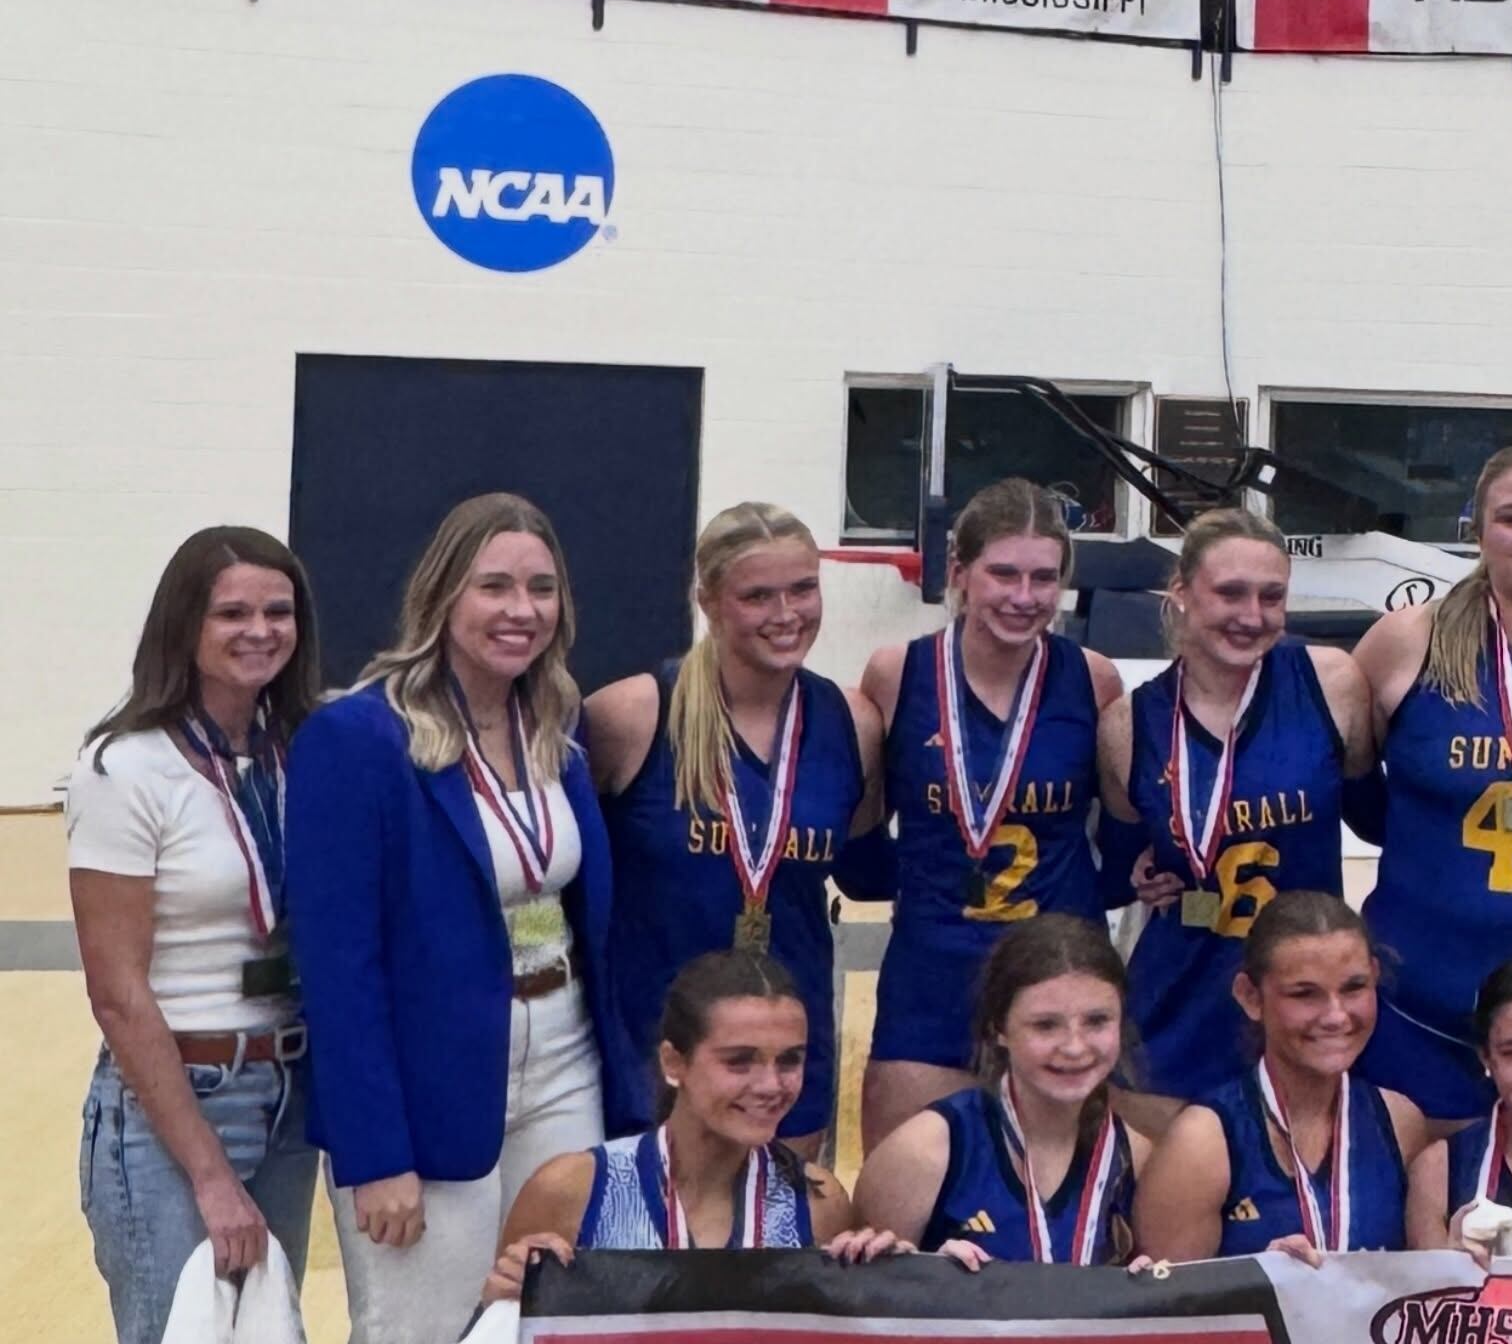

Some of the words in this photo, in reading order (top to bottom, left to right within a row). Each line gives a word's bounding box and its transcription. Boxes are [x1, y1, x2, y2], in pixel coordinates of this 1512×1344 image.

[432, 166, 608, 226] NCAA
[925, 780, 1073, 817] SALL
[686, 819, 834, 863] SUALL
[962, 823, 1039, 922] 2
[1210, 841, 1281, 939] 6
